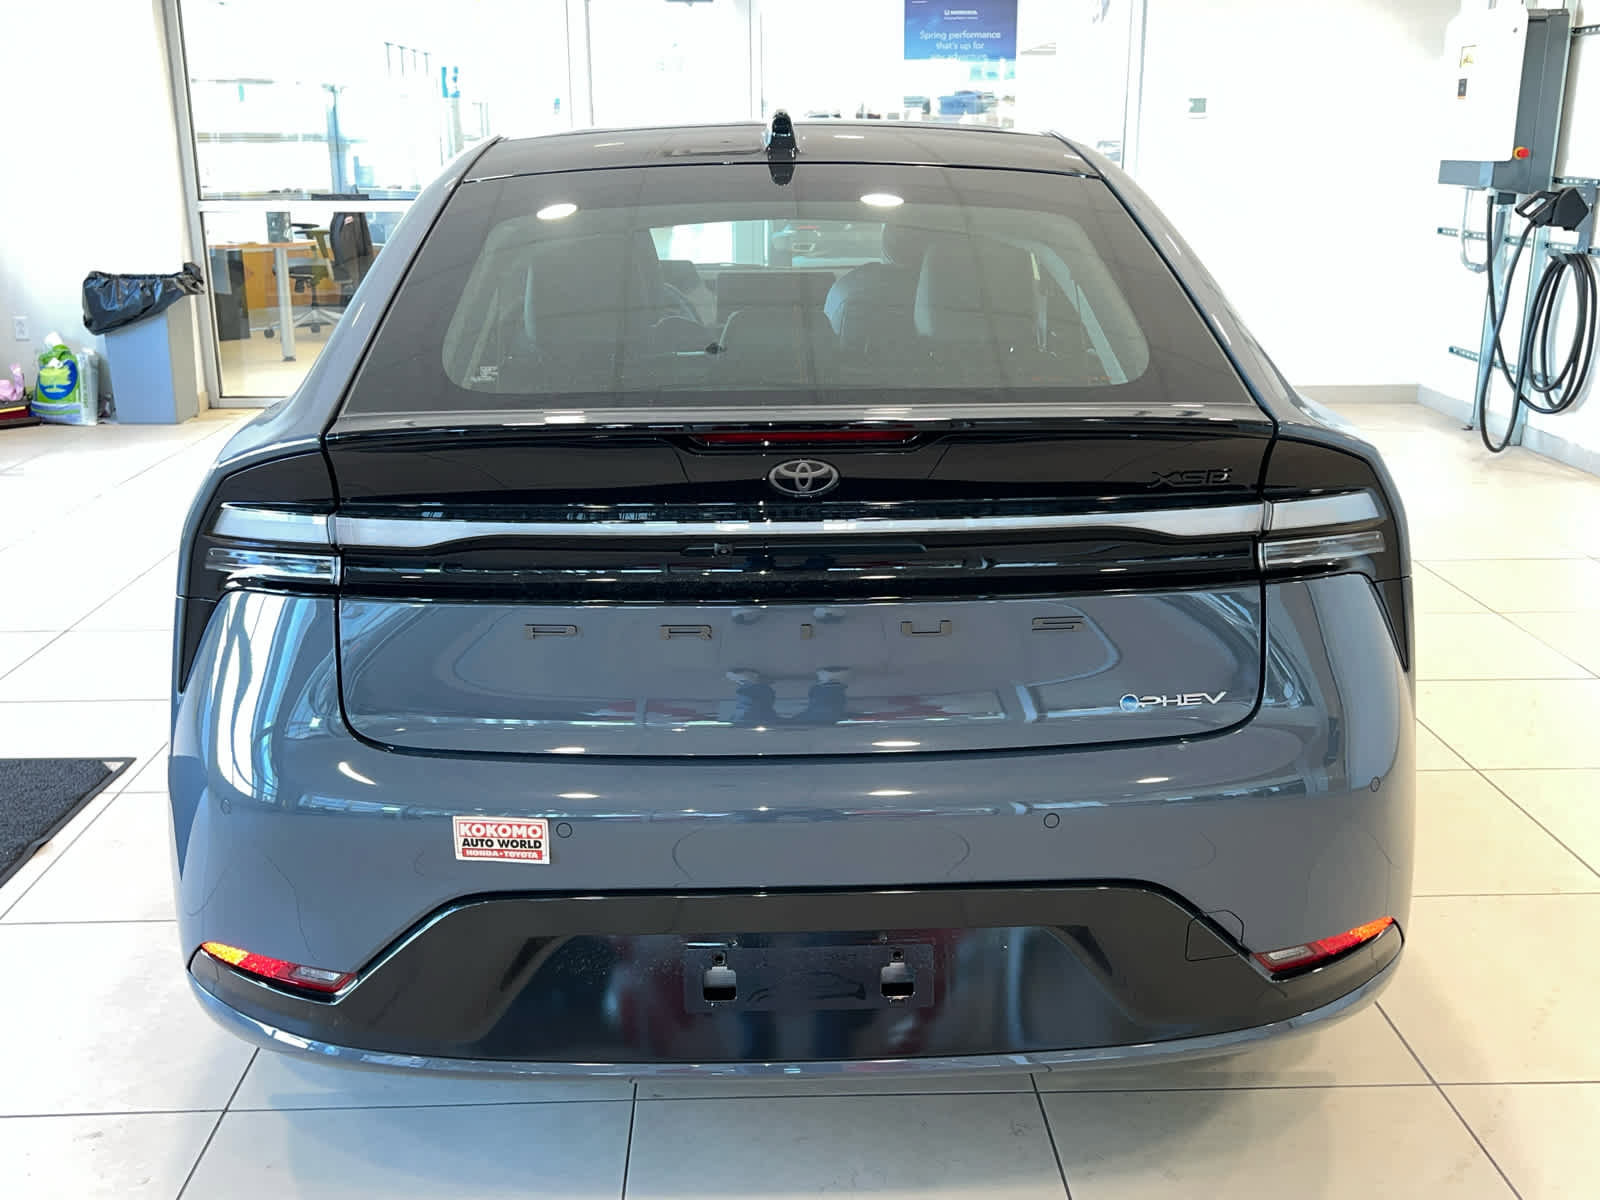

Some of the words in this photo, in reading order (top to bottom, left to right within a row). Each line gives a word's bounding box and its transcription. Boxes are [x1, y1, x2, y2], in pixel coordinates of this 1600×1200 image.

[920, 30, 946, 40] Spring
[948, 30, 1001, 40] performance
[936, 41, 958, 50] that's
[960, 43, 971, 51] up
[973, 41, 985, 50] for
[524, 615, 1084, 640] PRIUS
[460, 823, 541, 838] KOKOMO
[462, 838, 494, 848] AUTO
[497, 839, 542, 849] WORLD
